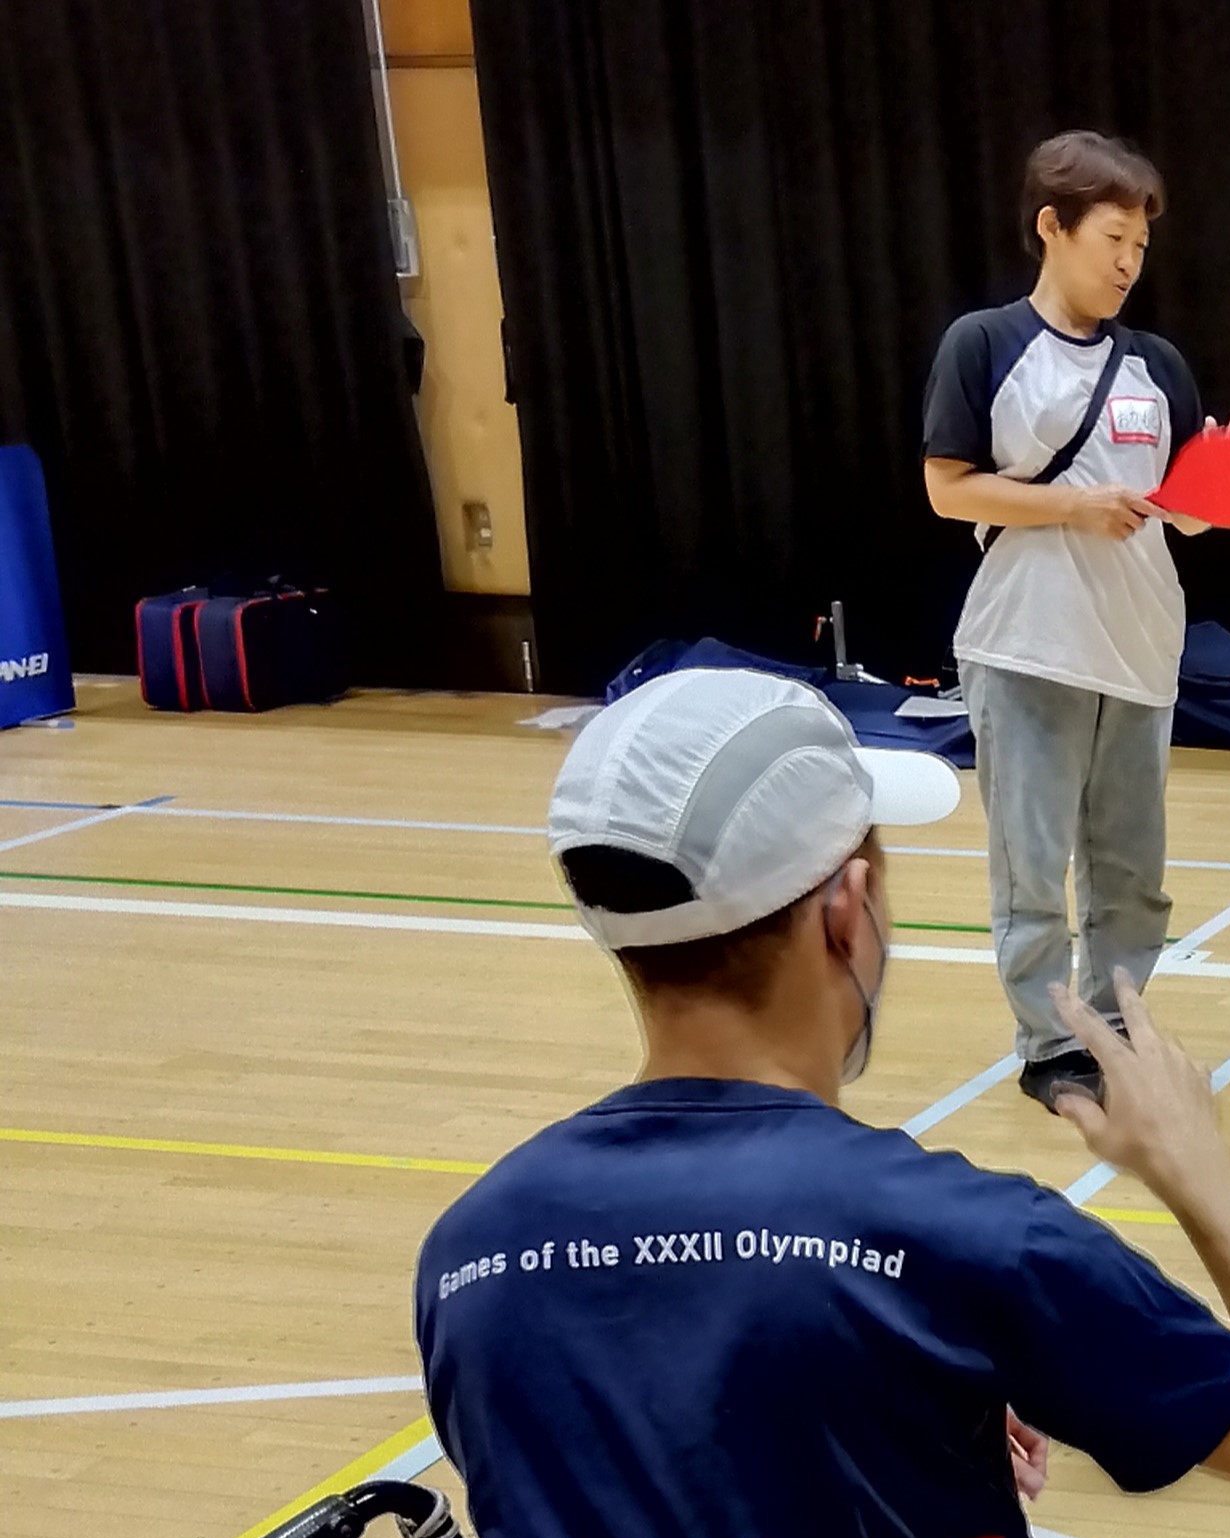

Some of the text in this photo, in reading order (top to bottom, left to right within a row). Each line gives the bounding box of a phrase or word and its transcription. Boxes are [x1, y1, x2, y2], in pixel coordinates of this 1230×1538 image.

[439, 1229, 905, 1299] Games of the XXXII Olympiad
